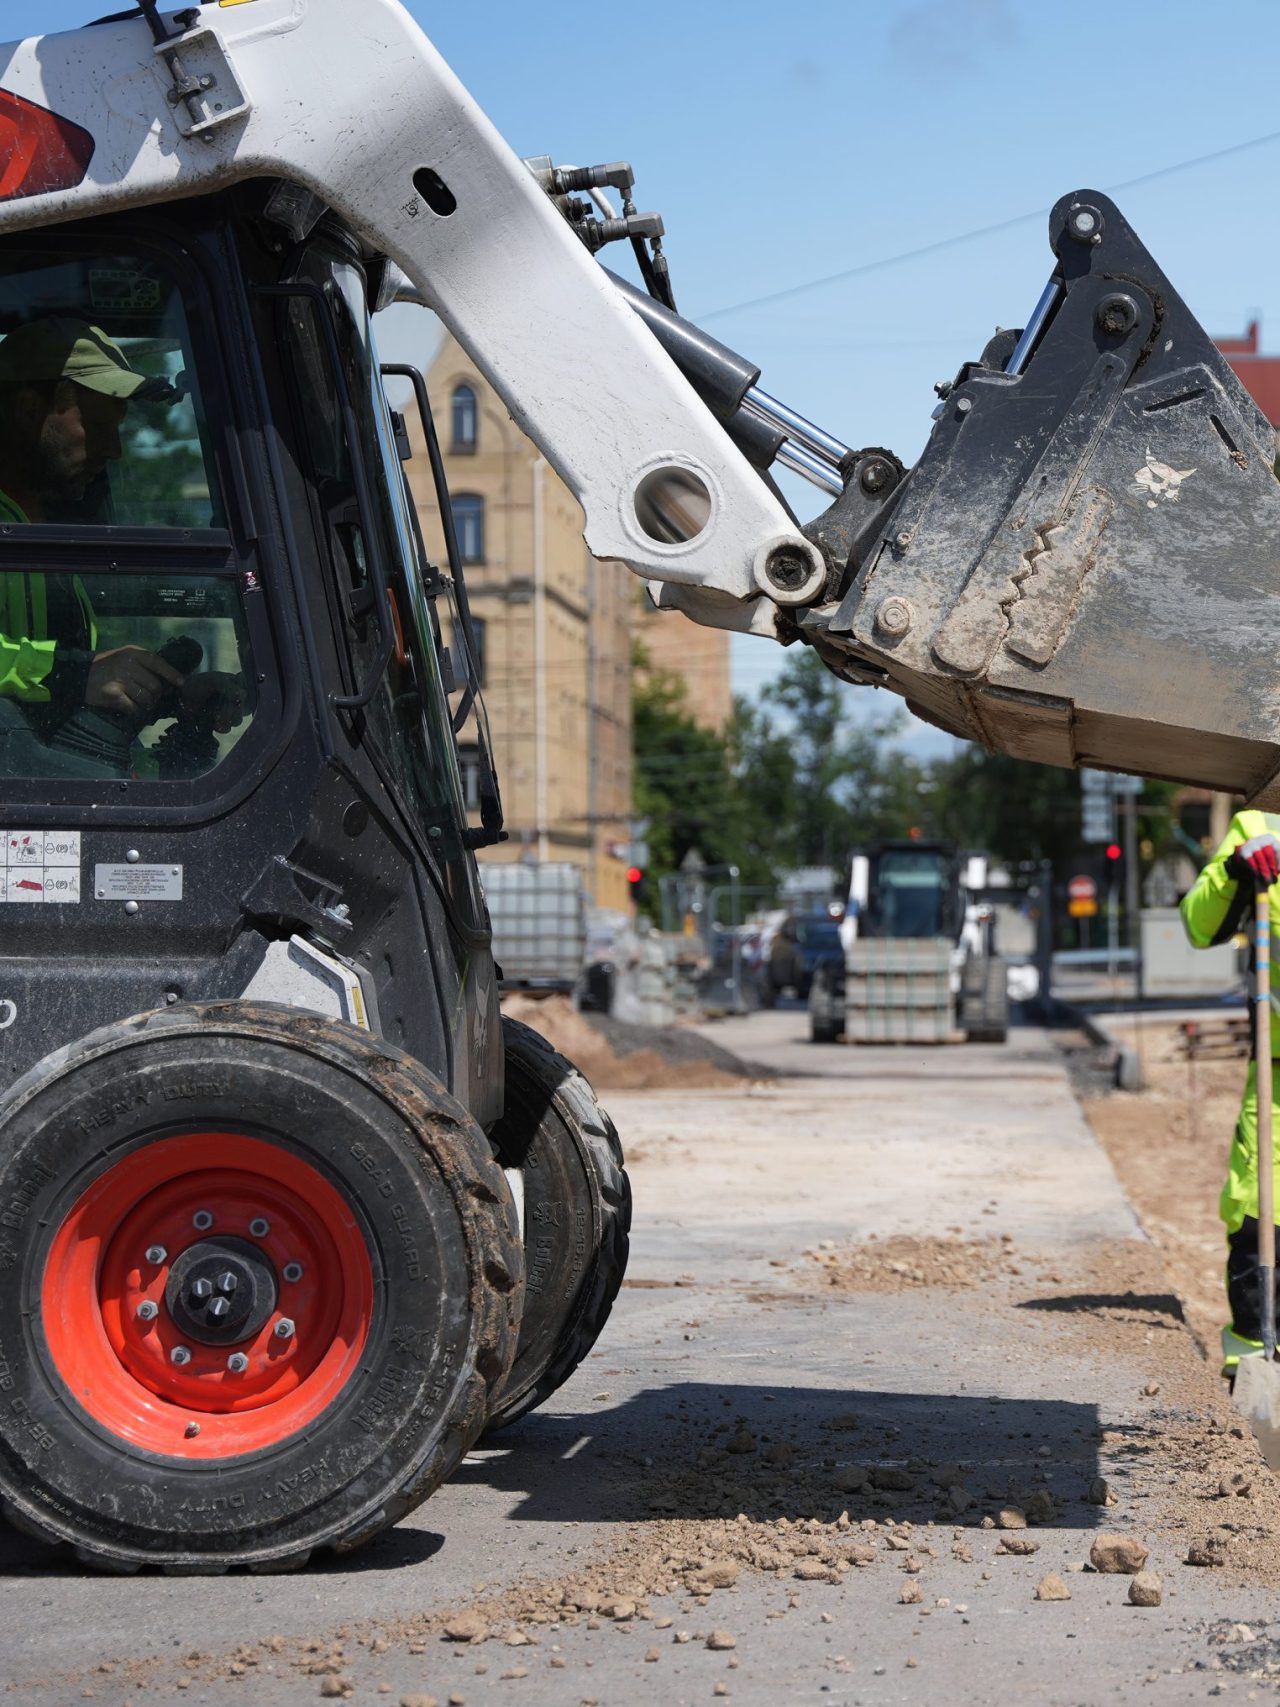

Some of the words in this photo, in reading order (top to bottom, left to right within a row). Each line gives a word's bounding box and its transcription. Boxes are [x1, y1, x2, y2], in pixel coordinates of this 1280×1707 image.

[79, 1089, 154, 1136] HEAVY
[160, 1080, 226, 1102] DUTY
[349, 1141, 395, 1199] BEAD
[391, 1202, 422, 1281] GUARD
[527, 1236, 553, 1295] Bobcat
[10, 1395, 57, 1453] BEAD
[178, 1493, 246, 1512] DUTY
[256, 1456, 330, 1502] HEAVY
